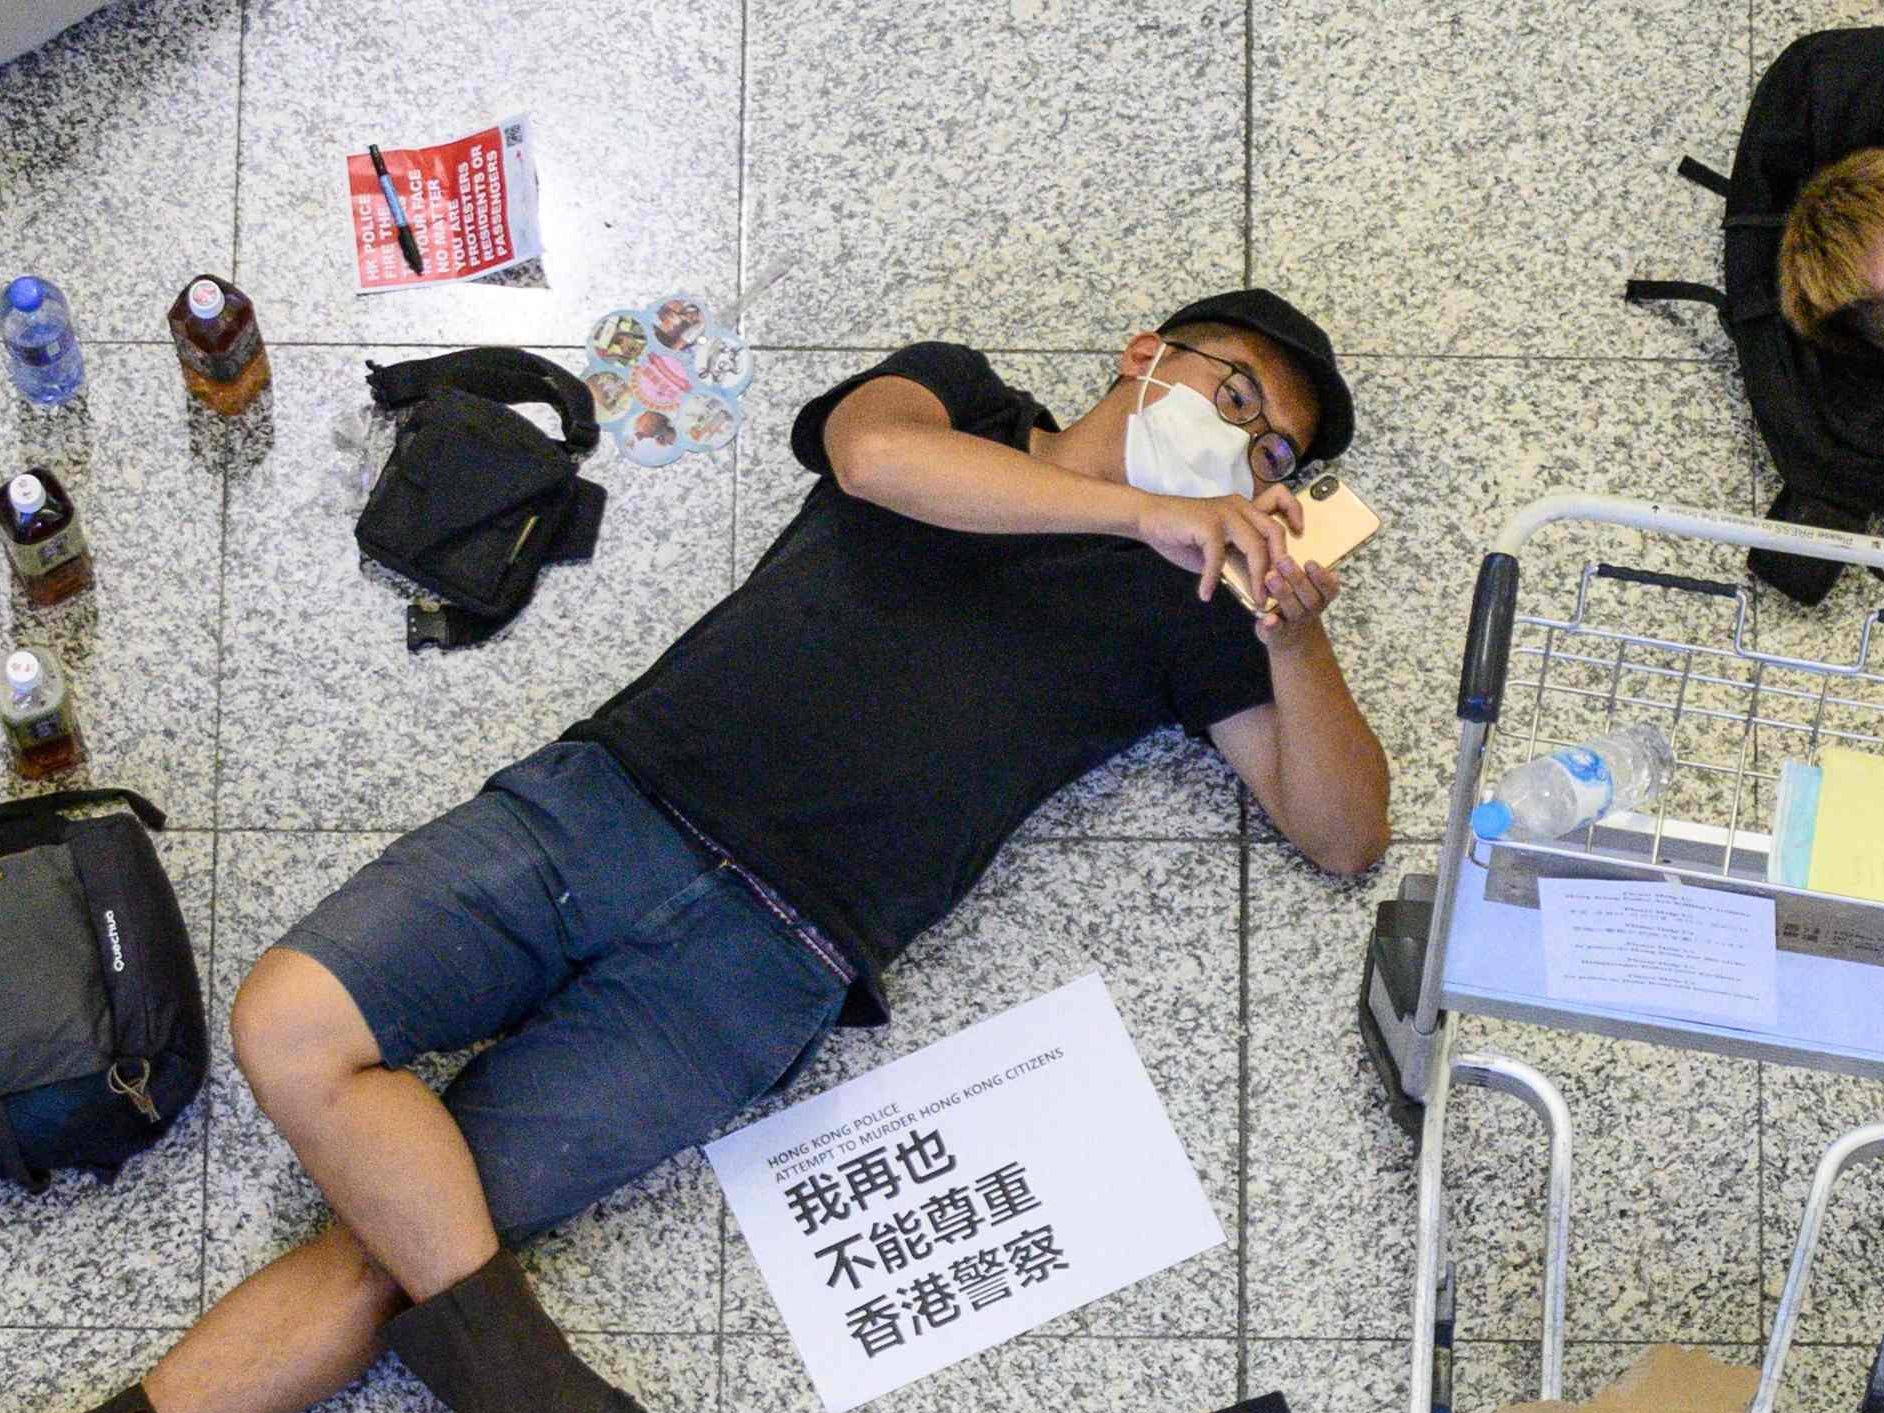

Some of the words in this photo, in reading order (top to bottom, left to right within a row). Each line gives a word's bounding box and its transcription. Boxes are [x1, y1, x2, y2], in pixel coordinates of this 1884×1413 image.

[470, 144, 484, 169] OR
[408, 168, 423, 210] FACE
[427, 178, 446, 245] MATTER
[449, 198, 461, 233] ARE
[457, 161, 481, 267] PROTESTERS
[473, 172, 494, 261] RESIDENTS
[486, 150, 508, 257] PASSENGERS
[359, 194, 375, 252] POLICE
[377, 207, 392, 240] THE
[413, 214, 430, 257] YOUR
[452, 237, 467, 272] YOU
[381, 243, 397, 279] FIRE
[437, 250, 450, 273] NO
[103, 909, 125, 973] Quechua
[767, 1141, 810, 1169] HONG
[811, 1123, 852, 1154] KONG
[853, 1102, 901, 1135] POLICE
[774, 1149, 835, 1184] ATTEMPT
[836, 1139, 857, 1157] TO
[859, 1111, 918, 1146] MURDER
[919, 1094, 962, 1119] HONG
[963, 1073, 1003, 1100] KONG
[1004, 1047, 1065, 1082] CITIZENS
[783, 1126, 958, 1237] 我再也
[813, 1159, 1042, 1292] 不能尊重
[844, 1222, 1071, 1359] 香港警察
